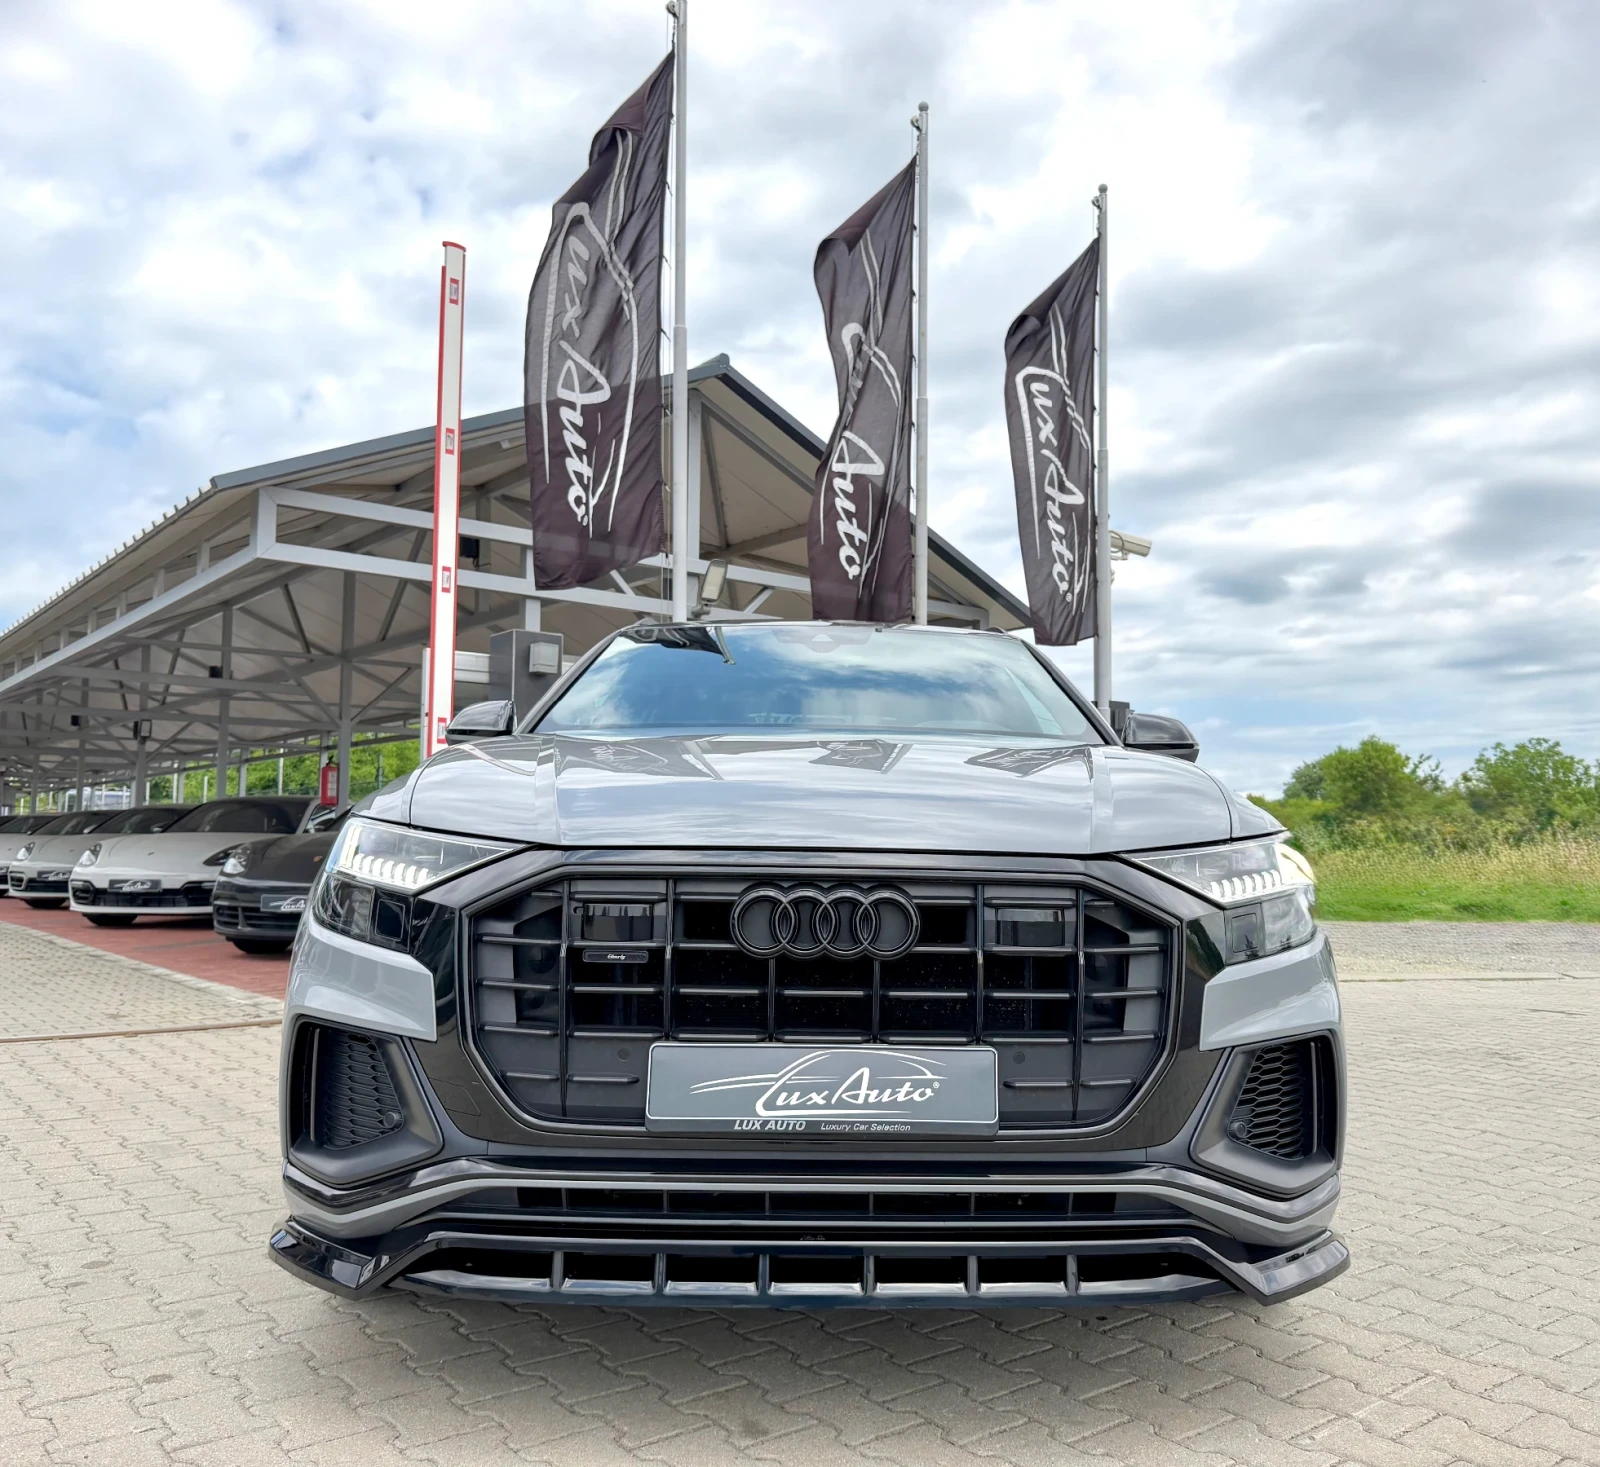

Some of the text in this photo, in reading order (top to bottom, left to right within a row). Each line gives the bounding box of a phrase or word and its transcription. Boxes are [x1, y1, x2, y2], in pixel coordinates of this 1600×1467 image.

[733, 1119, 807, 1132] LUX AUTO
[820, 1123, 911, 1132] Luxury Car Selection
